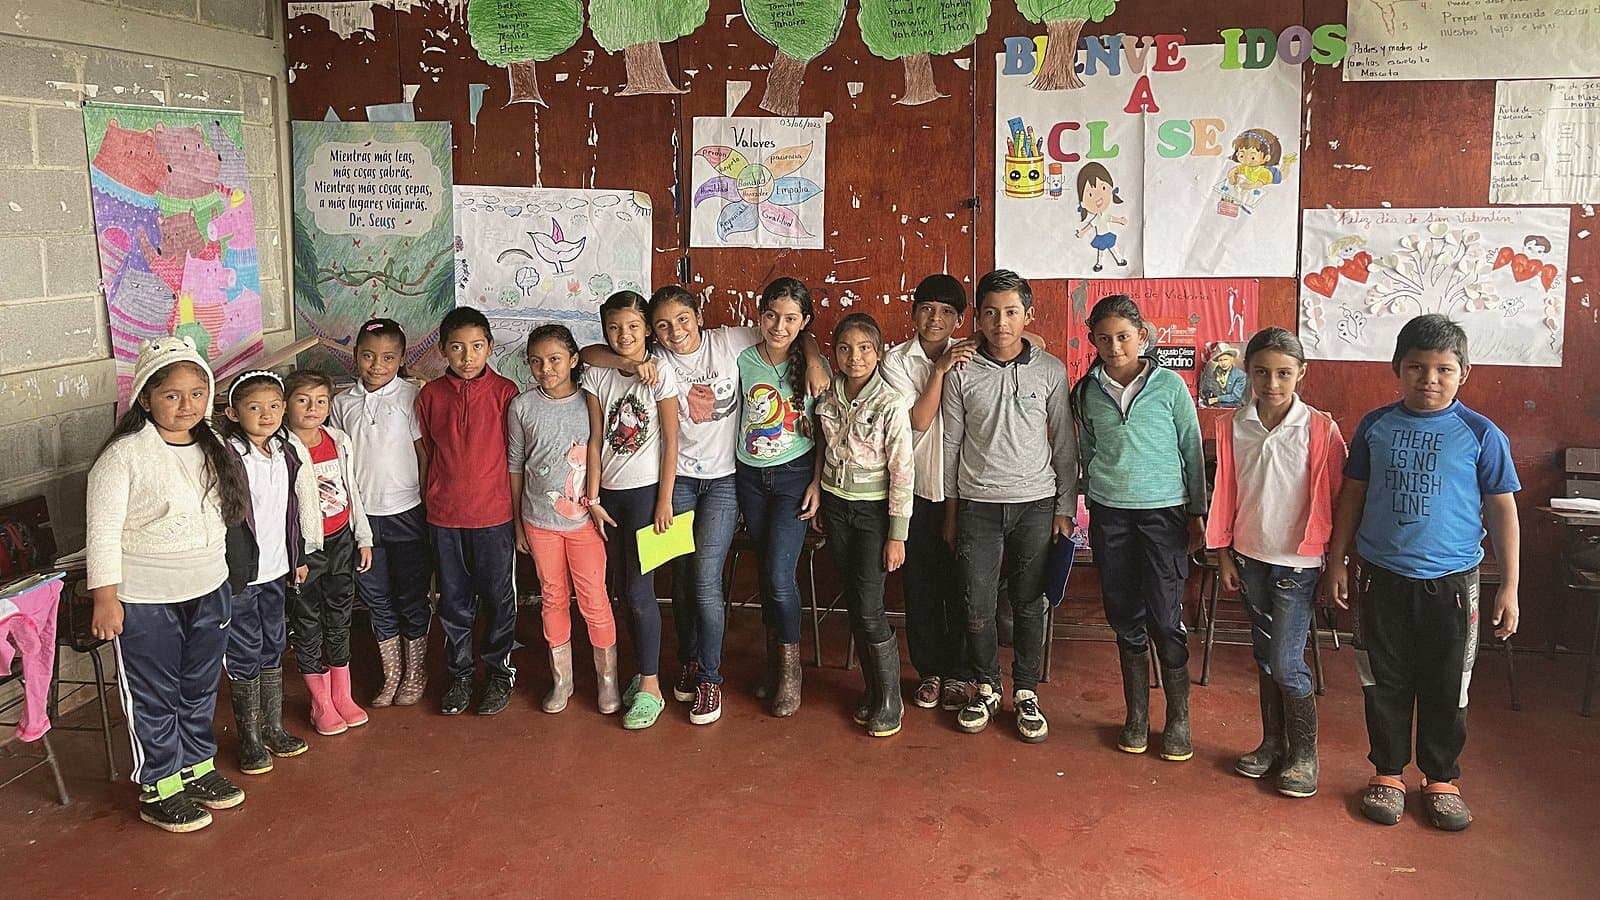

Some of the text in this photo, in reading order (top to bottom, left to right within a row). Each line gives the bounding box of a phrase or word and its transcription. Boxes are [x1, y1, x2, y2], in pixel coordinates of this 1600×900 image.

[1220, 24, 1347, 70] IDOS
[1124, 75, 1160, 114] A
[330, 150, 415, 165] Mientras más leas,
[333, 166, 412, 179] más cosas sabrás.
[314, 181, 432, 197] Mientras más cosas sepas,
[328, 197, 345, 210] más
[349, 197, 382, 212] lugares
[386, 197, 427, 213] viajarás.
[350, 213, 396, 229] Dr. Seuss
[1405, 212, 1418, 224] de
[1158, 327, 1171, 344] 21
[1156, 347, 1178, 356] Augusto
[1158, 355, 1194, 367] Sandino
[1392, 429, 1445, 451] THERE
[1390, 450, 1437, 472] IS NO
[1385, 470, 1442, 495] FINISH
[1392, 493, 1430, 516] LINE
